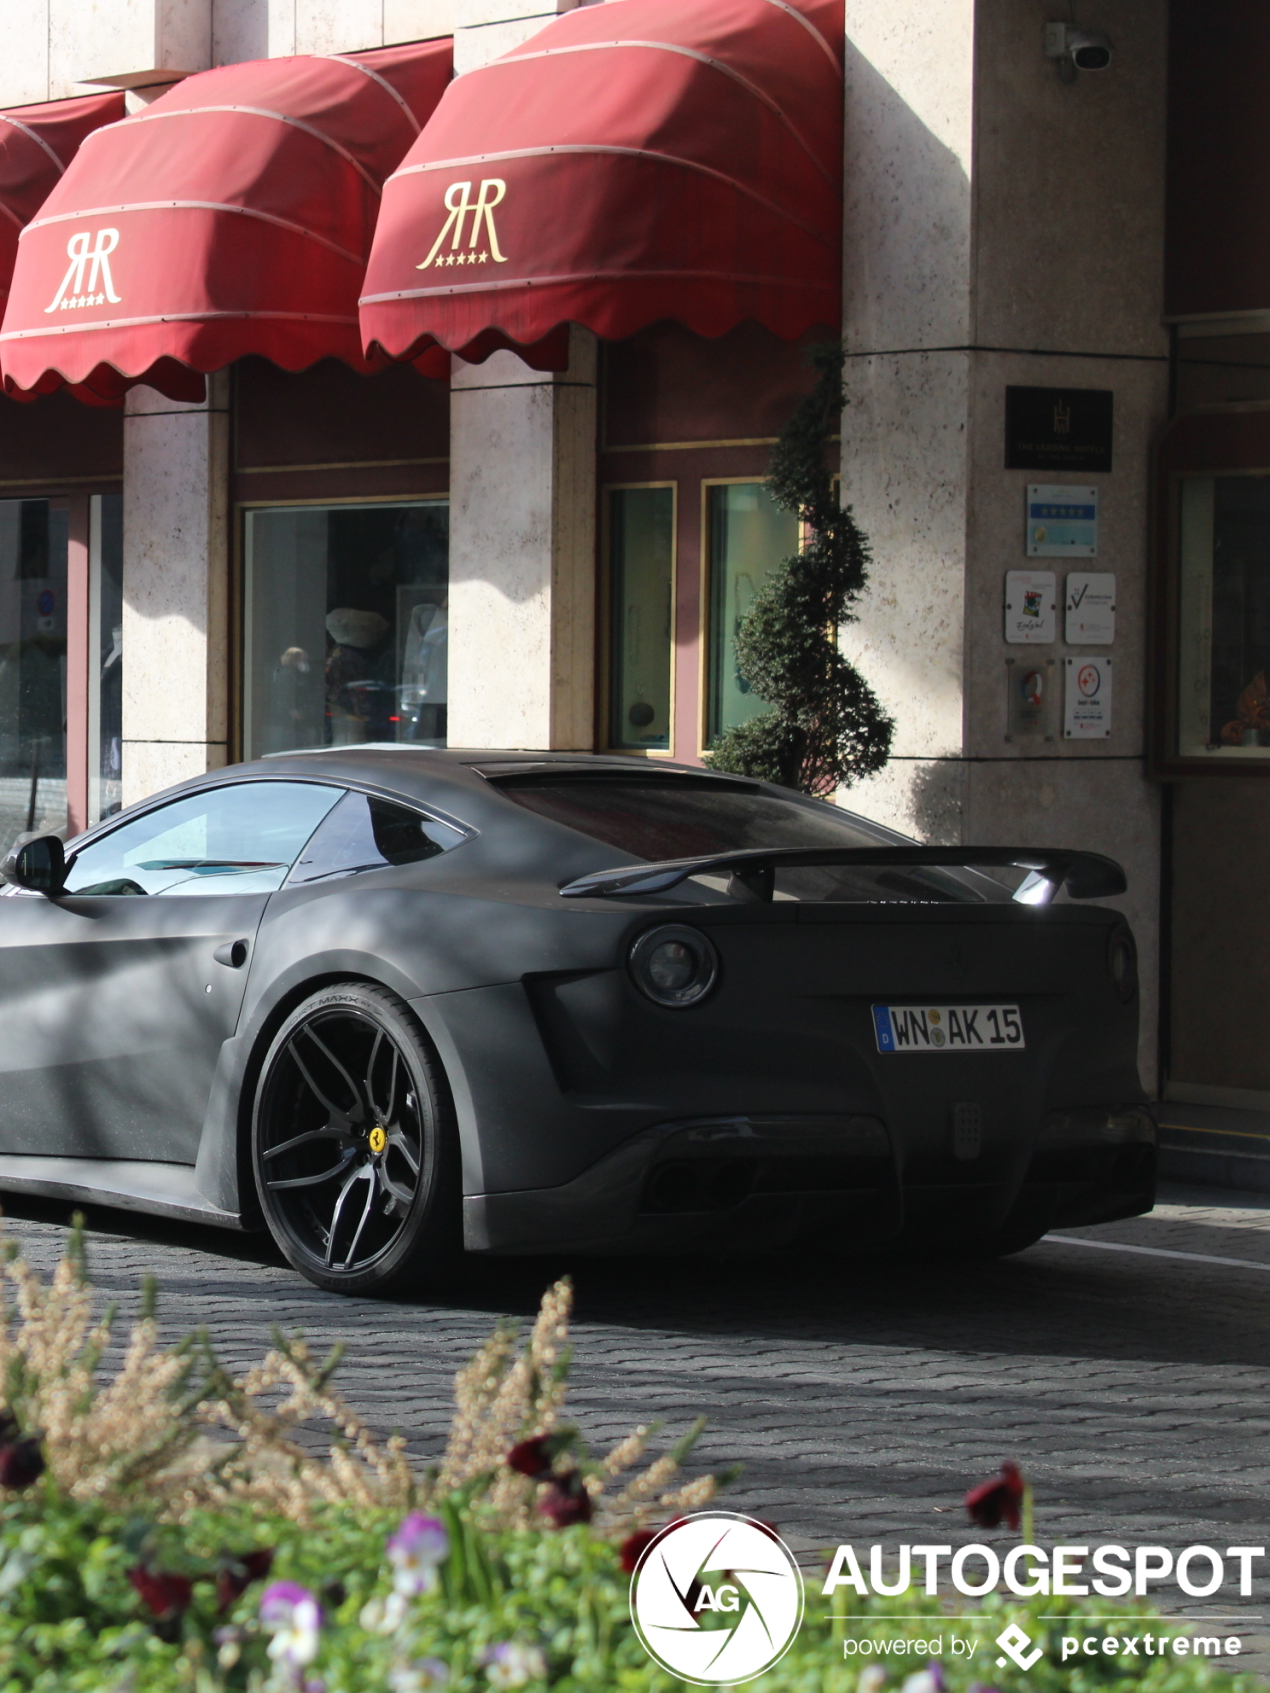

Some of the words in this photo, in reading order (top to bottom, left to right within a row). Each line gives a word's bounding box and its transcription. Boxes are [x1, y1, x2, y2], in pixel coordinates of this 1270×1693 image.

[882, 1033, 889, 1044] D
[891, 1010, 930, 1046] WN
[948, 1009, 983, 1045] AK
[987, 1008, 1021, 1044] 15
